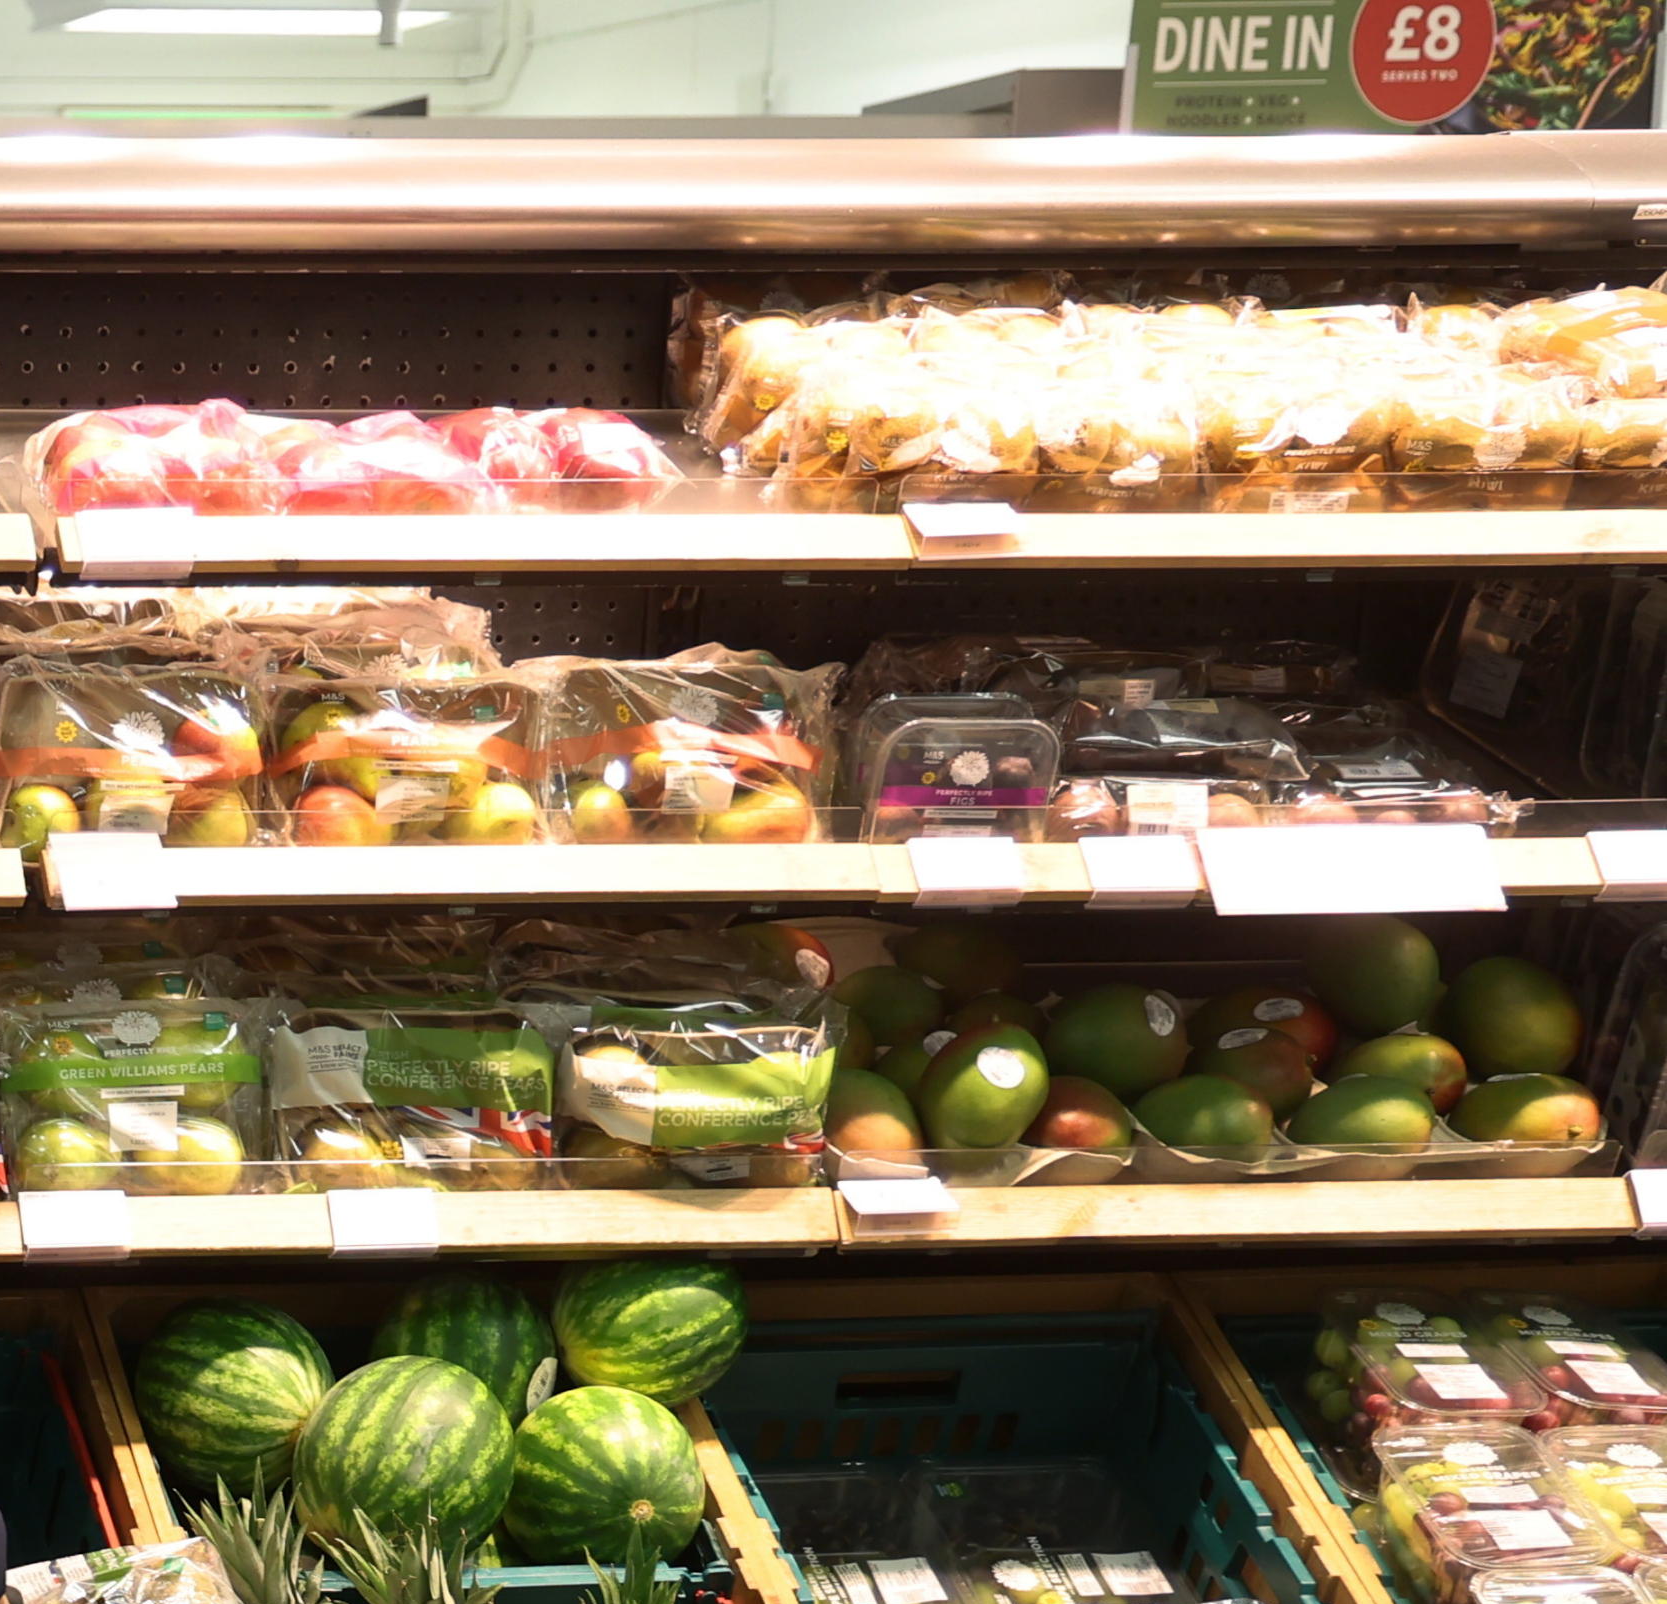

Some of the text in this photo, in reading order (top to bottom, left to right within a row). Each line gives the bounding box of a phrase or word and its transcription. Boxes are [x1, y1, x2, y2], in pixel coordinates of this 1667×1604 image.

[1384, 4, 1462, 62] £8
[1153, 15, 1334, 73] DINE IN
[1382, 69, 1458, 83] SERVES TWO
[1174, 95, 1290, 109] PROTEIN VEG
[1167, 113, 1307, 127] NOODLES SAUCE
[948, 797, 977, 806] FIGS
[104, 1048, 154, 1058] PERFECTLY
[59, 1061, 226, 1080] GREEN WILLIAMS PEARS
[367, 1059, 463, 1075] PERFECTLY
[469, 1060, 511, 1077] RIPE
[366, 1073, 547, 1092] CONFERENCE PEARS
[763, 1095, 804, 1111] RIPE
[657, 1112, 783, 1128] CONFERENCE
[1025, 1536, 1062, 1583] SELECTION
[801, 1546, 836, 1593] SELECTION
